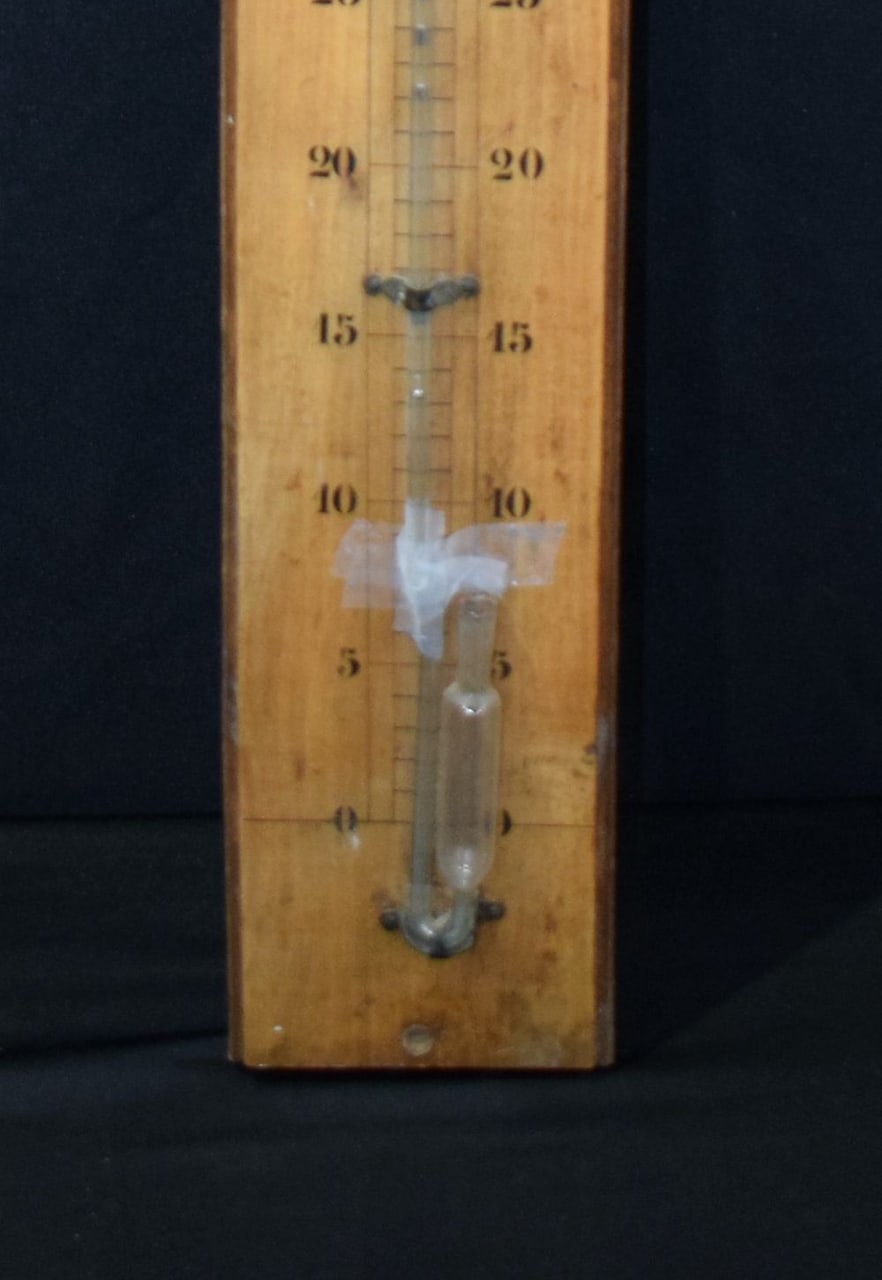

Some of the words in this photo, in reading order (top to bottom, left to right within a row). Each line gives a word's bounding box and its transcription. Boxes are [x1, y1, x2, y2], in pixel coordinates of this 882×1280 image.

[308, 145, 356, 179] 20
[491, 147, 544, 181] 20
[316, 312, 358, 346] 15
[489, 321, 533, 354] 15
[315, 484, 357, 515] 10
[488, 487, 532, 518] 10
[337, 646, 361, 678] 5
[333, 806, 357, 833] 0
